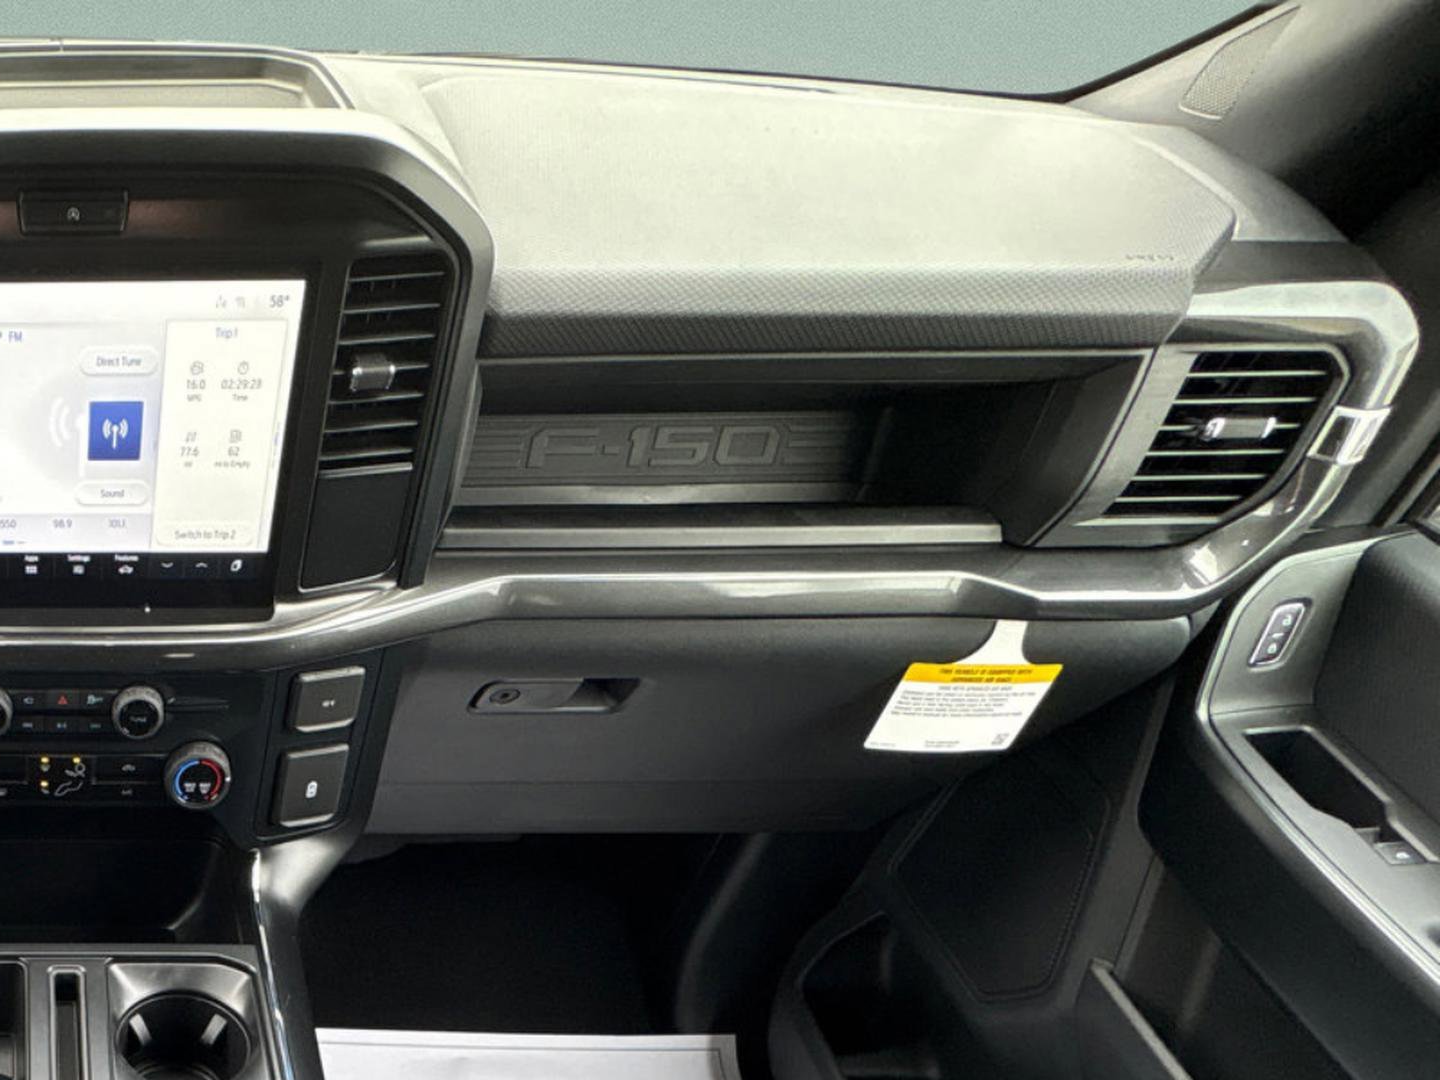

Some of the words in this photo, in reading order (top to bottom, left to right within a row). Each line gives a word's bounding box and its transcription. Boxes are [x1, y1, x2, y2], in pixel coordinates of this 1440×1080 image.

[8, 330, 23, 342] FM
[96, 356, 120, 367] Direct
[121, 356, 142, 367] Tune
[228, 446, 240, 457] 62
[525, 424, 781, 468] F-150
[100, 488, 125, 498] Sound
[174, 530, 201, 540] Switch
[203, 530, 212, 540] to
[213, 530, 229, 542] Trip
